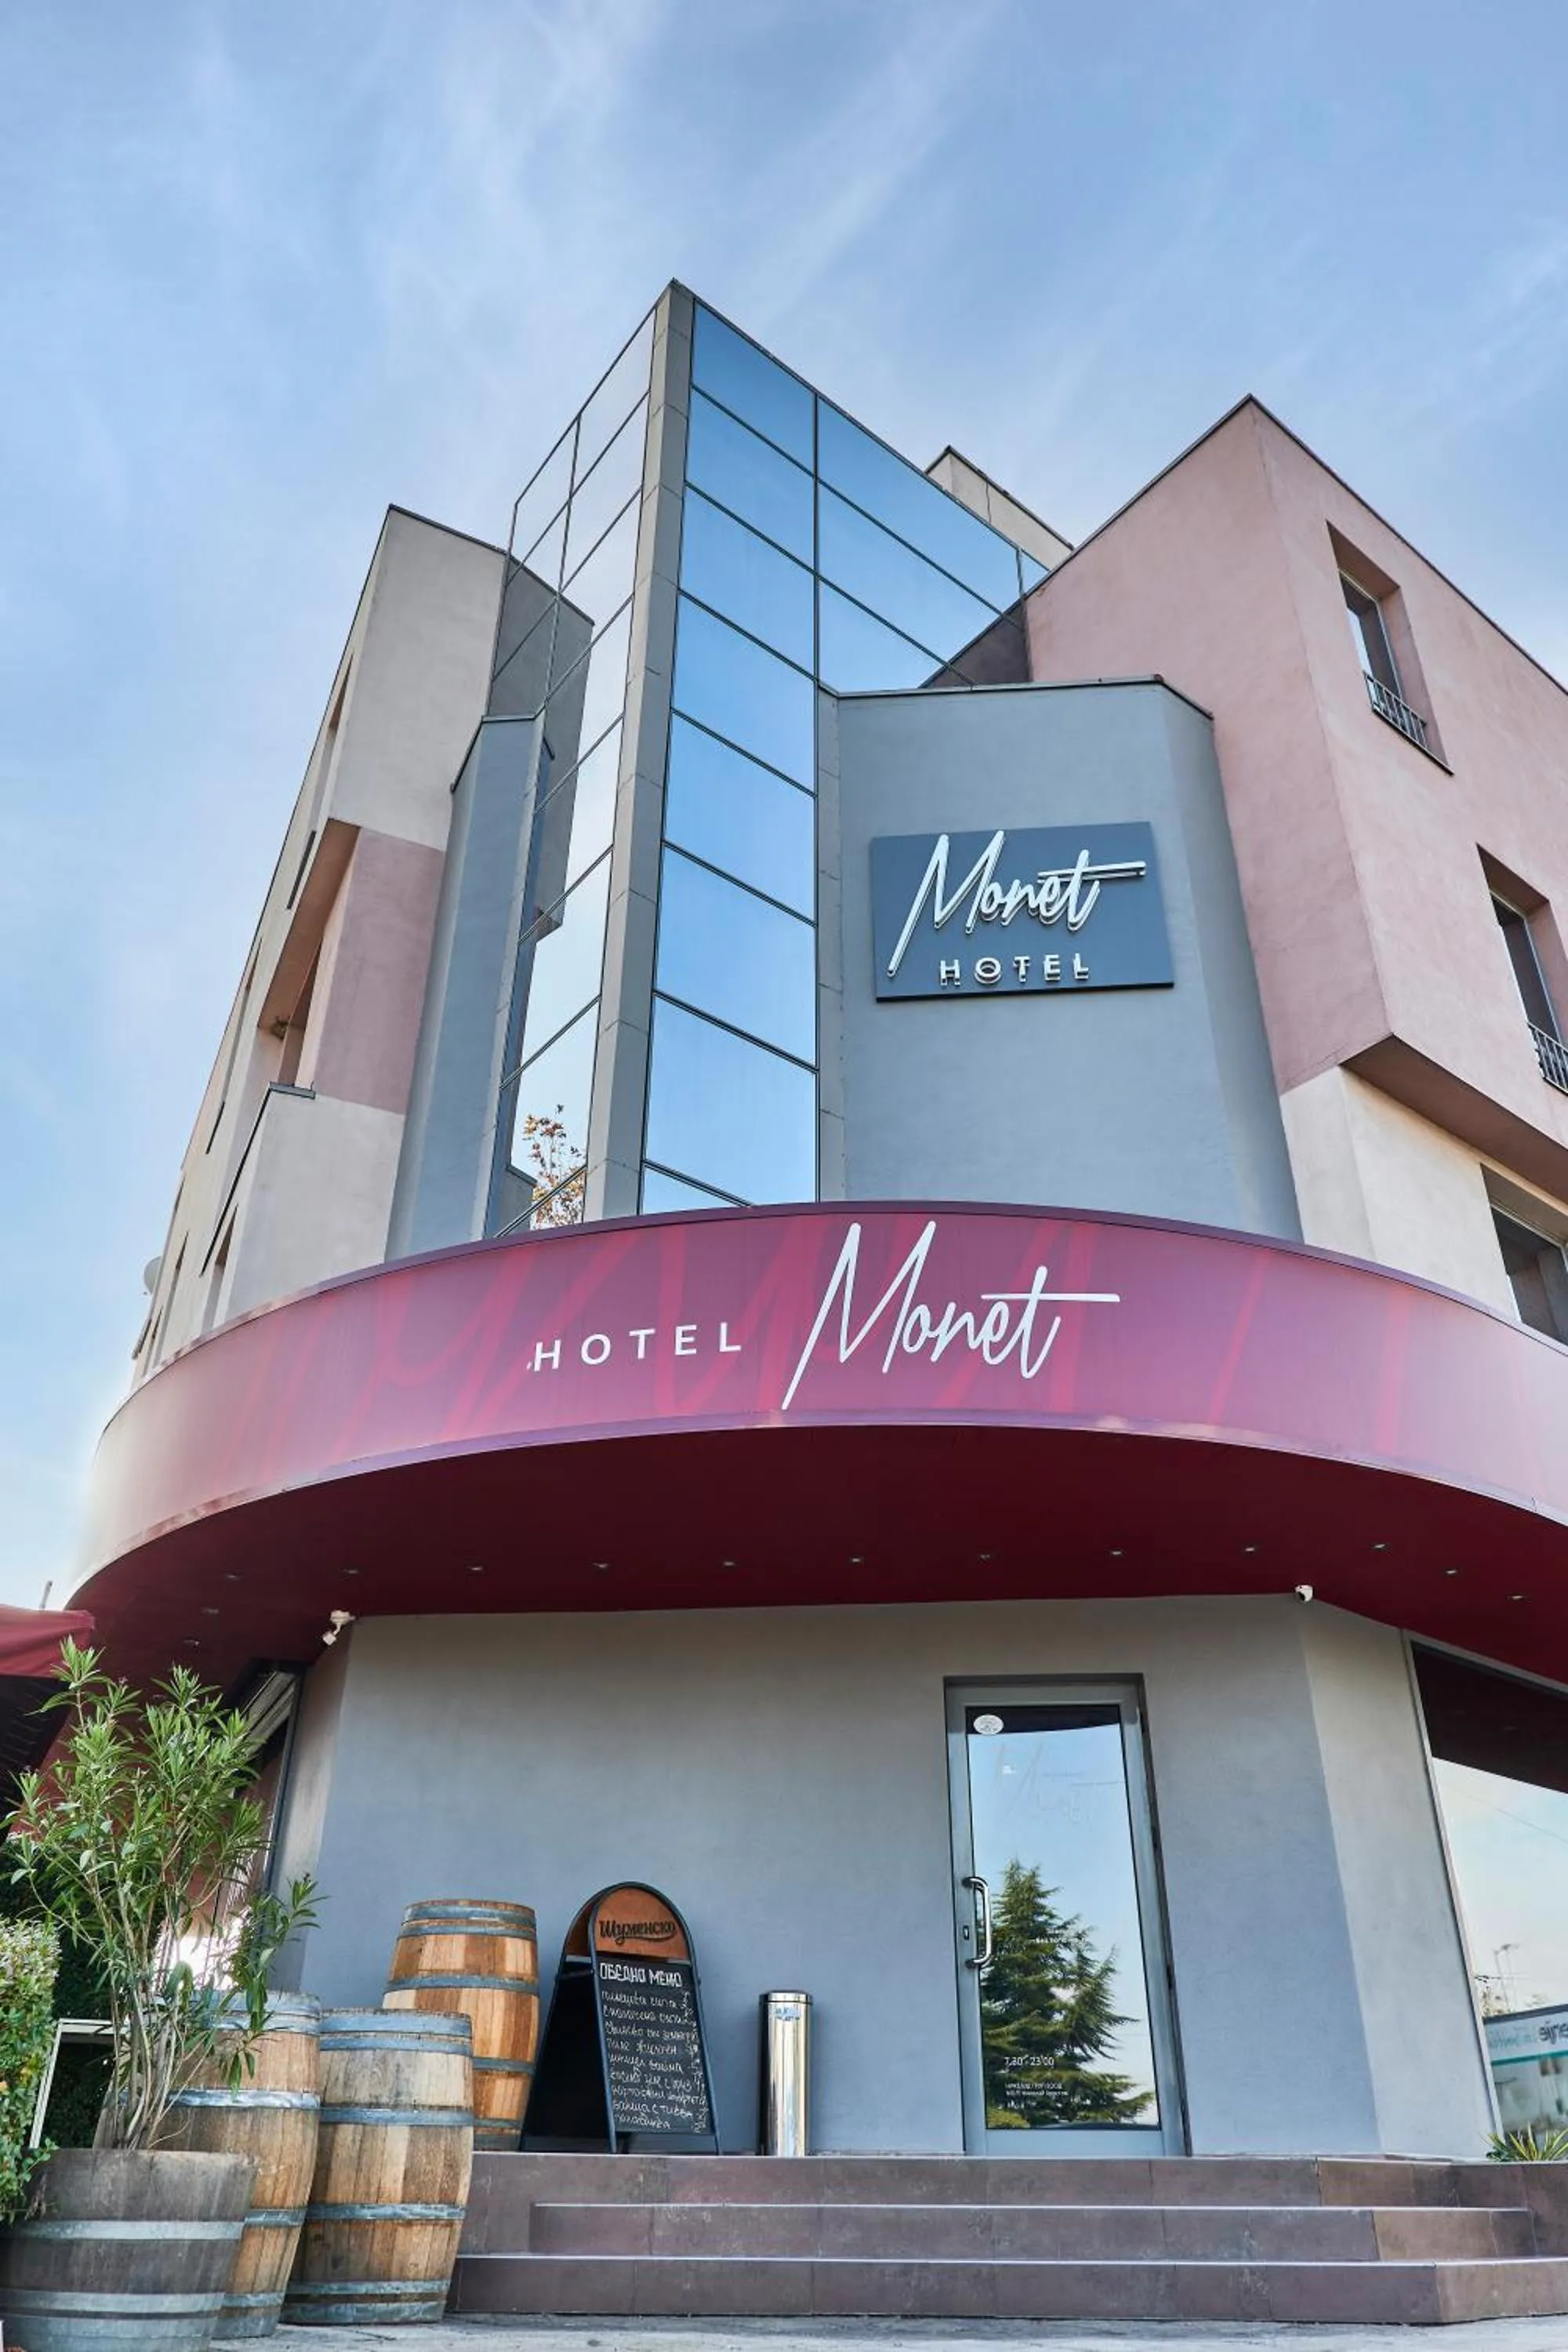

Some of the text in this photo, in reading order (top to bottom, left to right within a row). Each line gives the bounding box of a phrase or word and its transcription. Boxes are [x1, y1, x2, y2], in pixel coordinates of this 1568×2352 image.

[887, 829, 1147, 978] Monet
[940, 953, 1090, 986] HOTEL
[532, 1220, 1121, 1410] HOTEL Monet
[600, 1962, 646, 1983] ОБЕДНО
